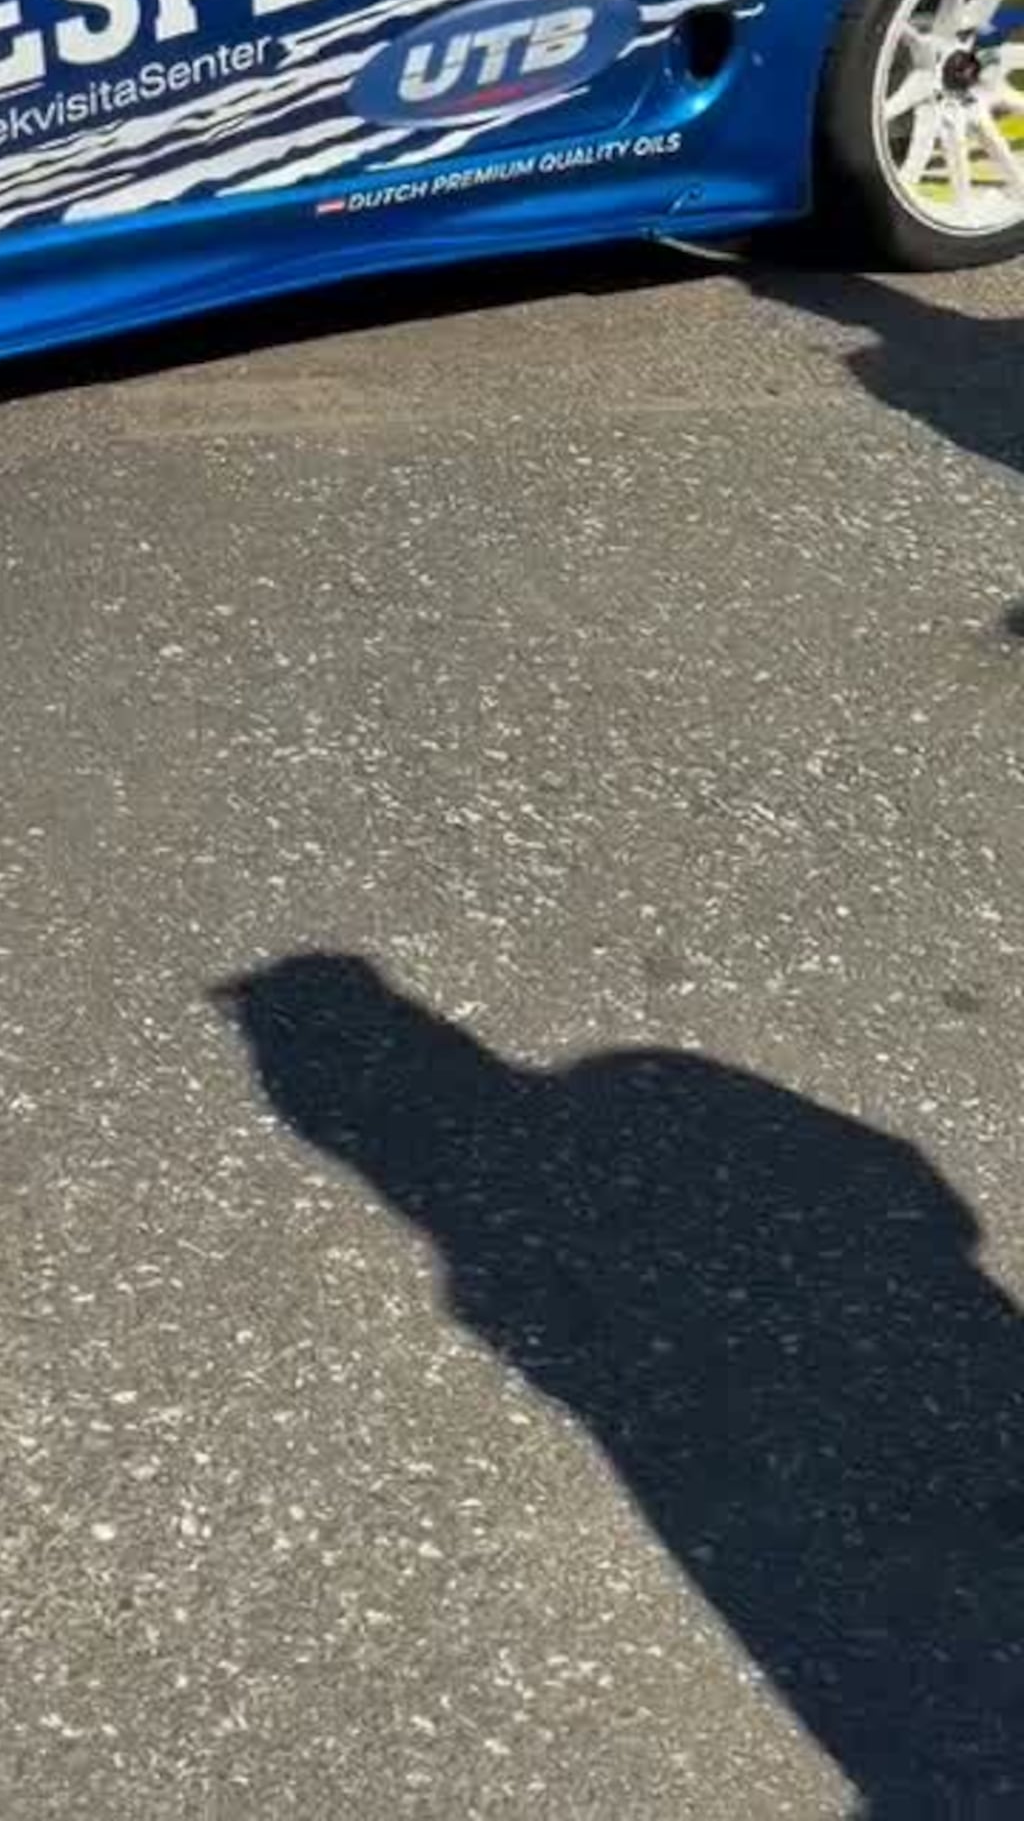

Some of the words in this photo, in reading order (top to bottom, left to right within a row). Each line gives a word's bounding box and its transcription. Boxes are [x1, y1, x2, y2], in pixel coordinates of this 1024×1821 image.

[397, 7, 595, 102] UTB
[347, 182, 428, 212] DUTCH
[431, 159, 534, 196] PREMIUM
[537, 138, 630, 175] QUALITY
[633, 132, 683, 157] OILS
